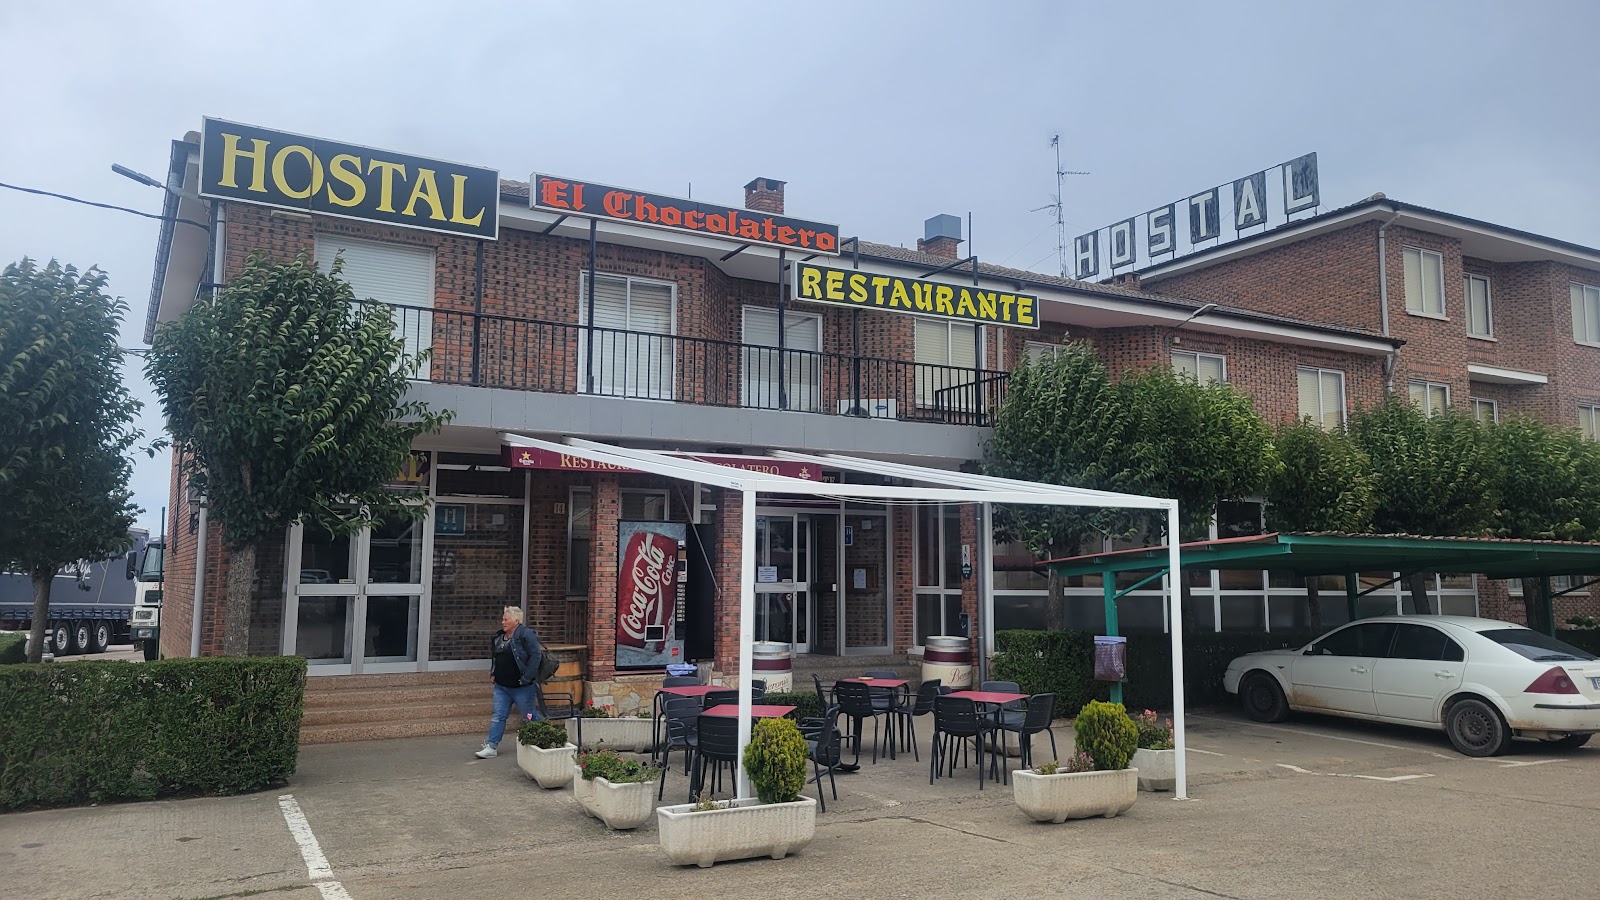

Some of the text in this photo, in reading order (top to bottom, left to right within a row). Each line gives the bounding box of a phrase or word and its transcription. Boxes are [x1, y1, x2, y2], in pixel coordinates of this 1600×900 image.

[218, 132, 486, 228] HOSTAL
[539, 178, 836, 251] El Chocolatero
[1075, 164, 1313, 278] HOSTAL
[802, 267, 1034, 325] RESTAURANTE
[620, 540, 665, 640] Coca-Cola
[661, 555, 676, 586] Coke
